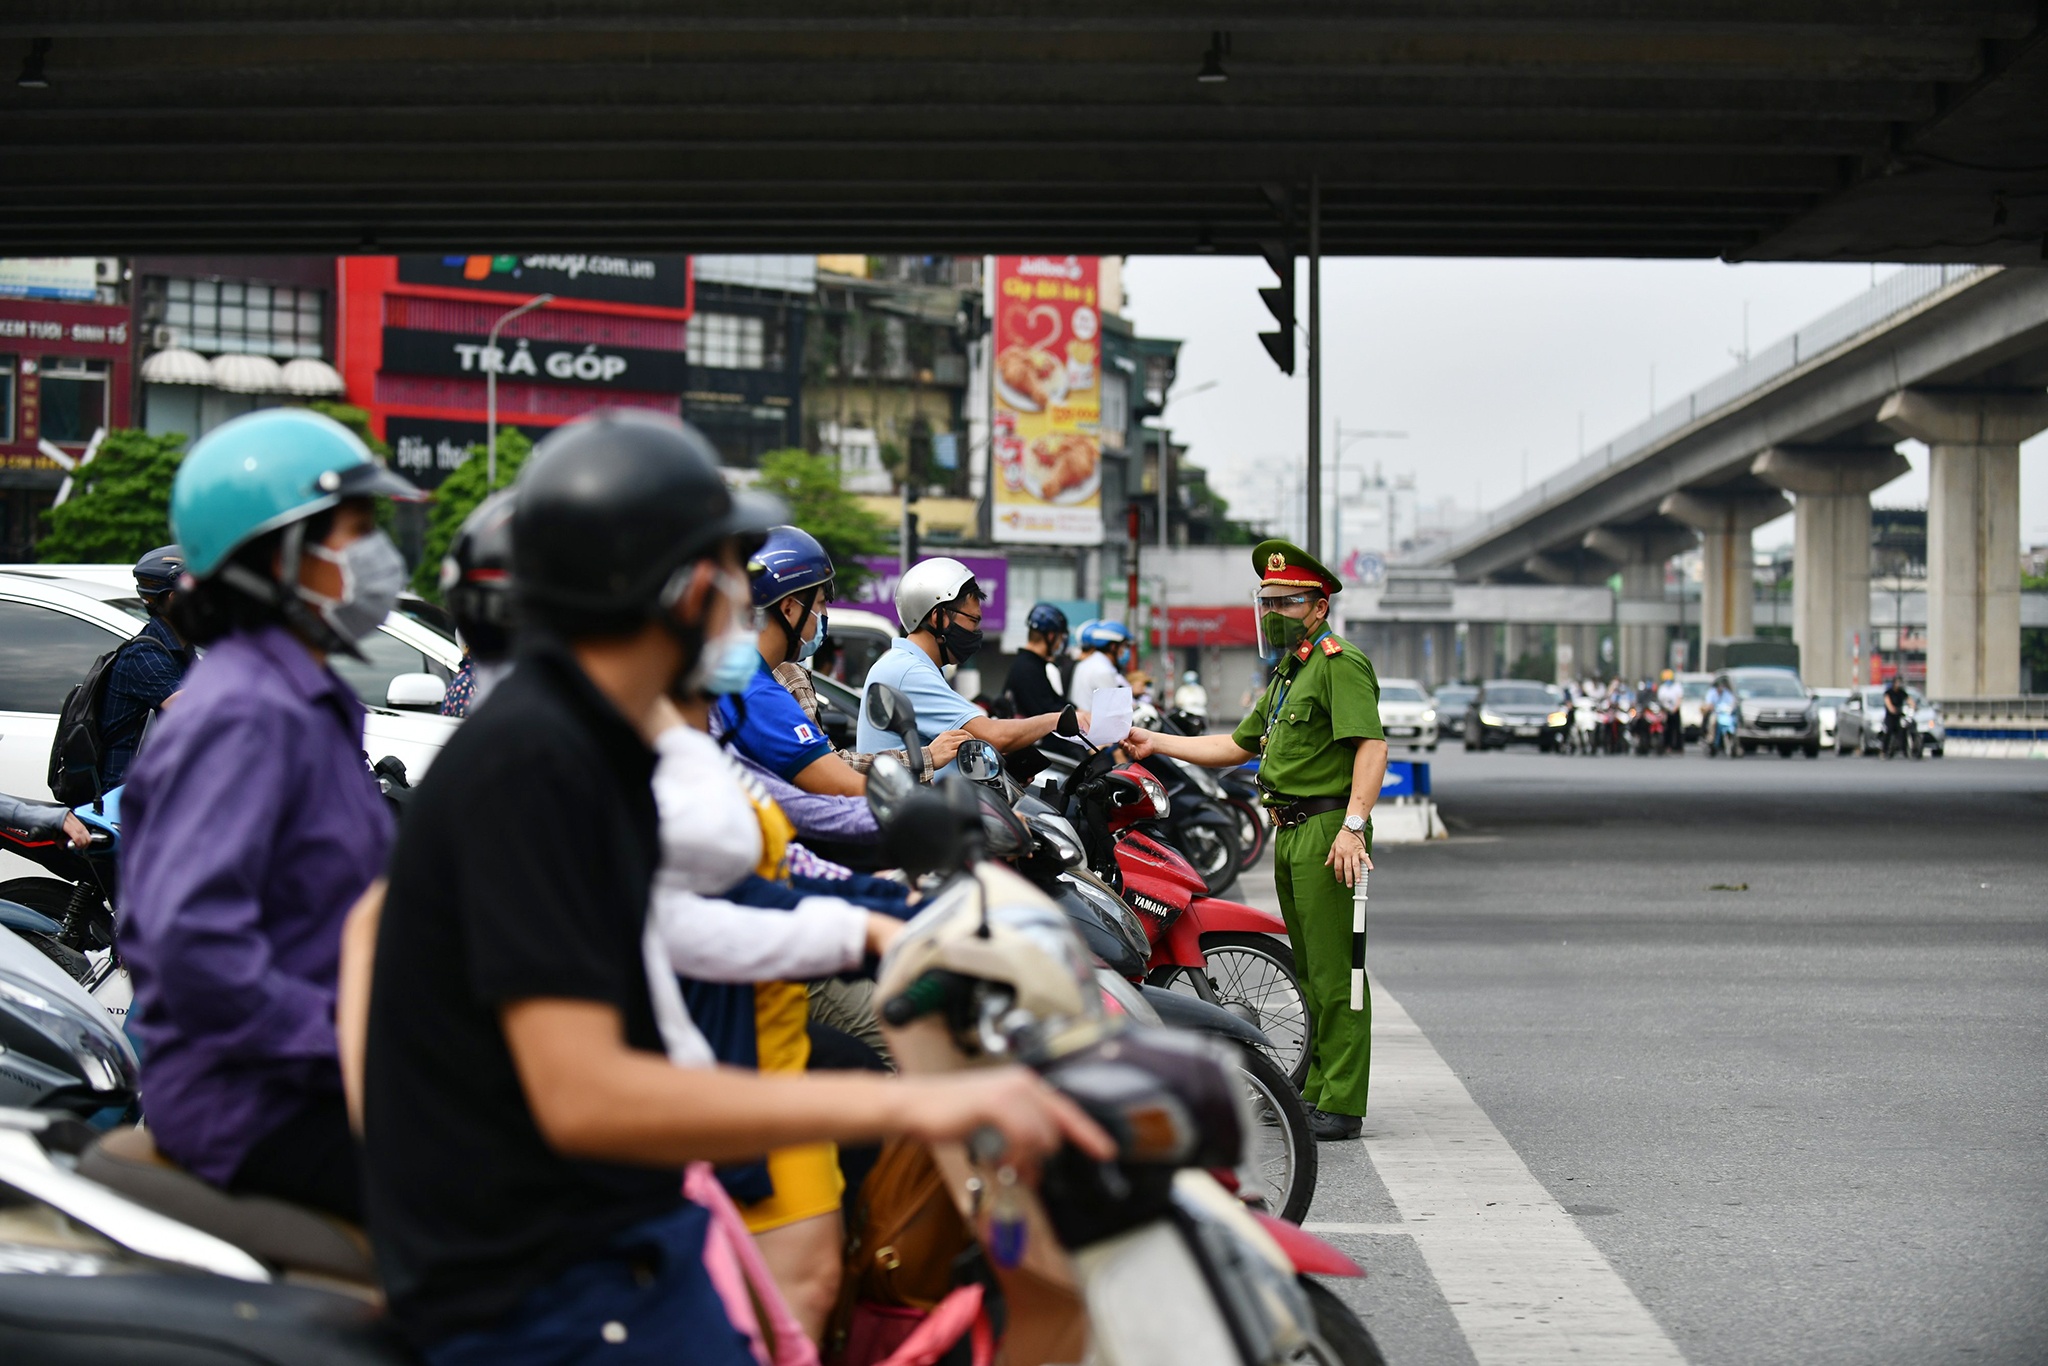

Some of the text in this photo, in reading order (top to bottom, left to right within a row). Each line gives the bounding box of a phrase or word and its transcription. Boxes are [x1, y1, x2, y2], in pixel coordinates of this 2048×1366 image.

[454, 338, 627, 381] TRẢ GÓP
[1134, 894, 1168, 918] YAMAHA
